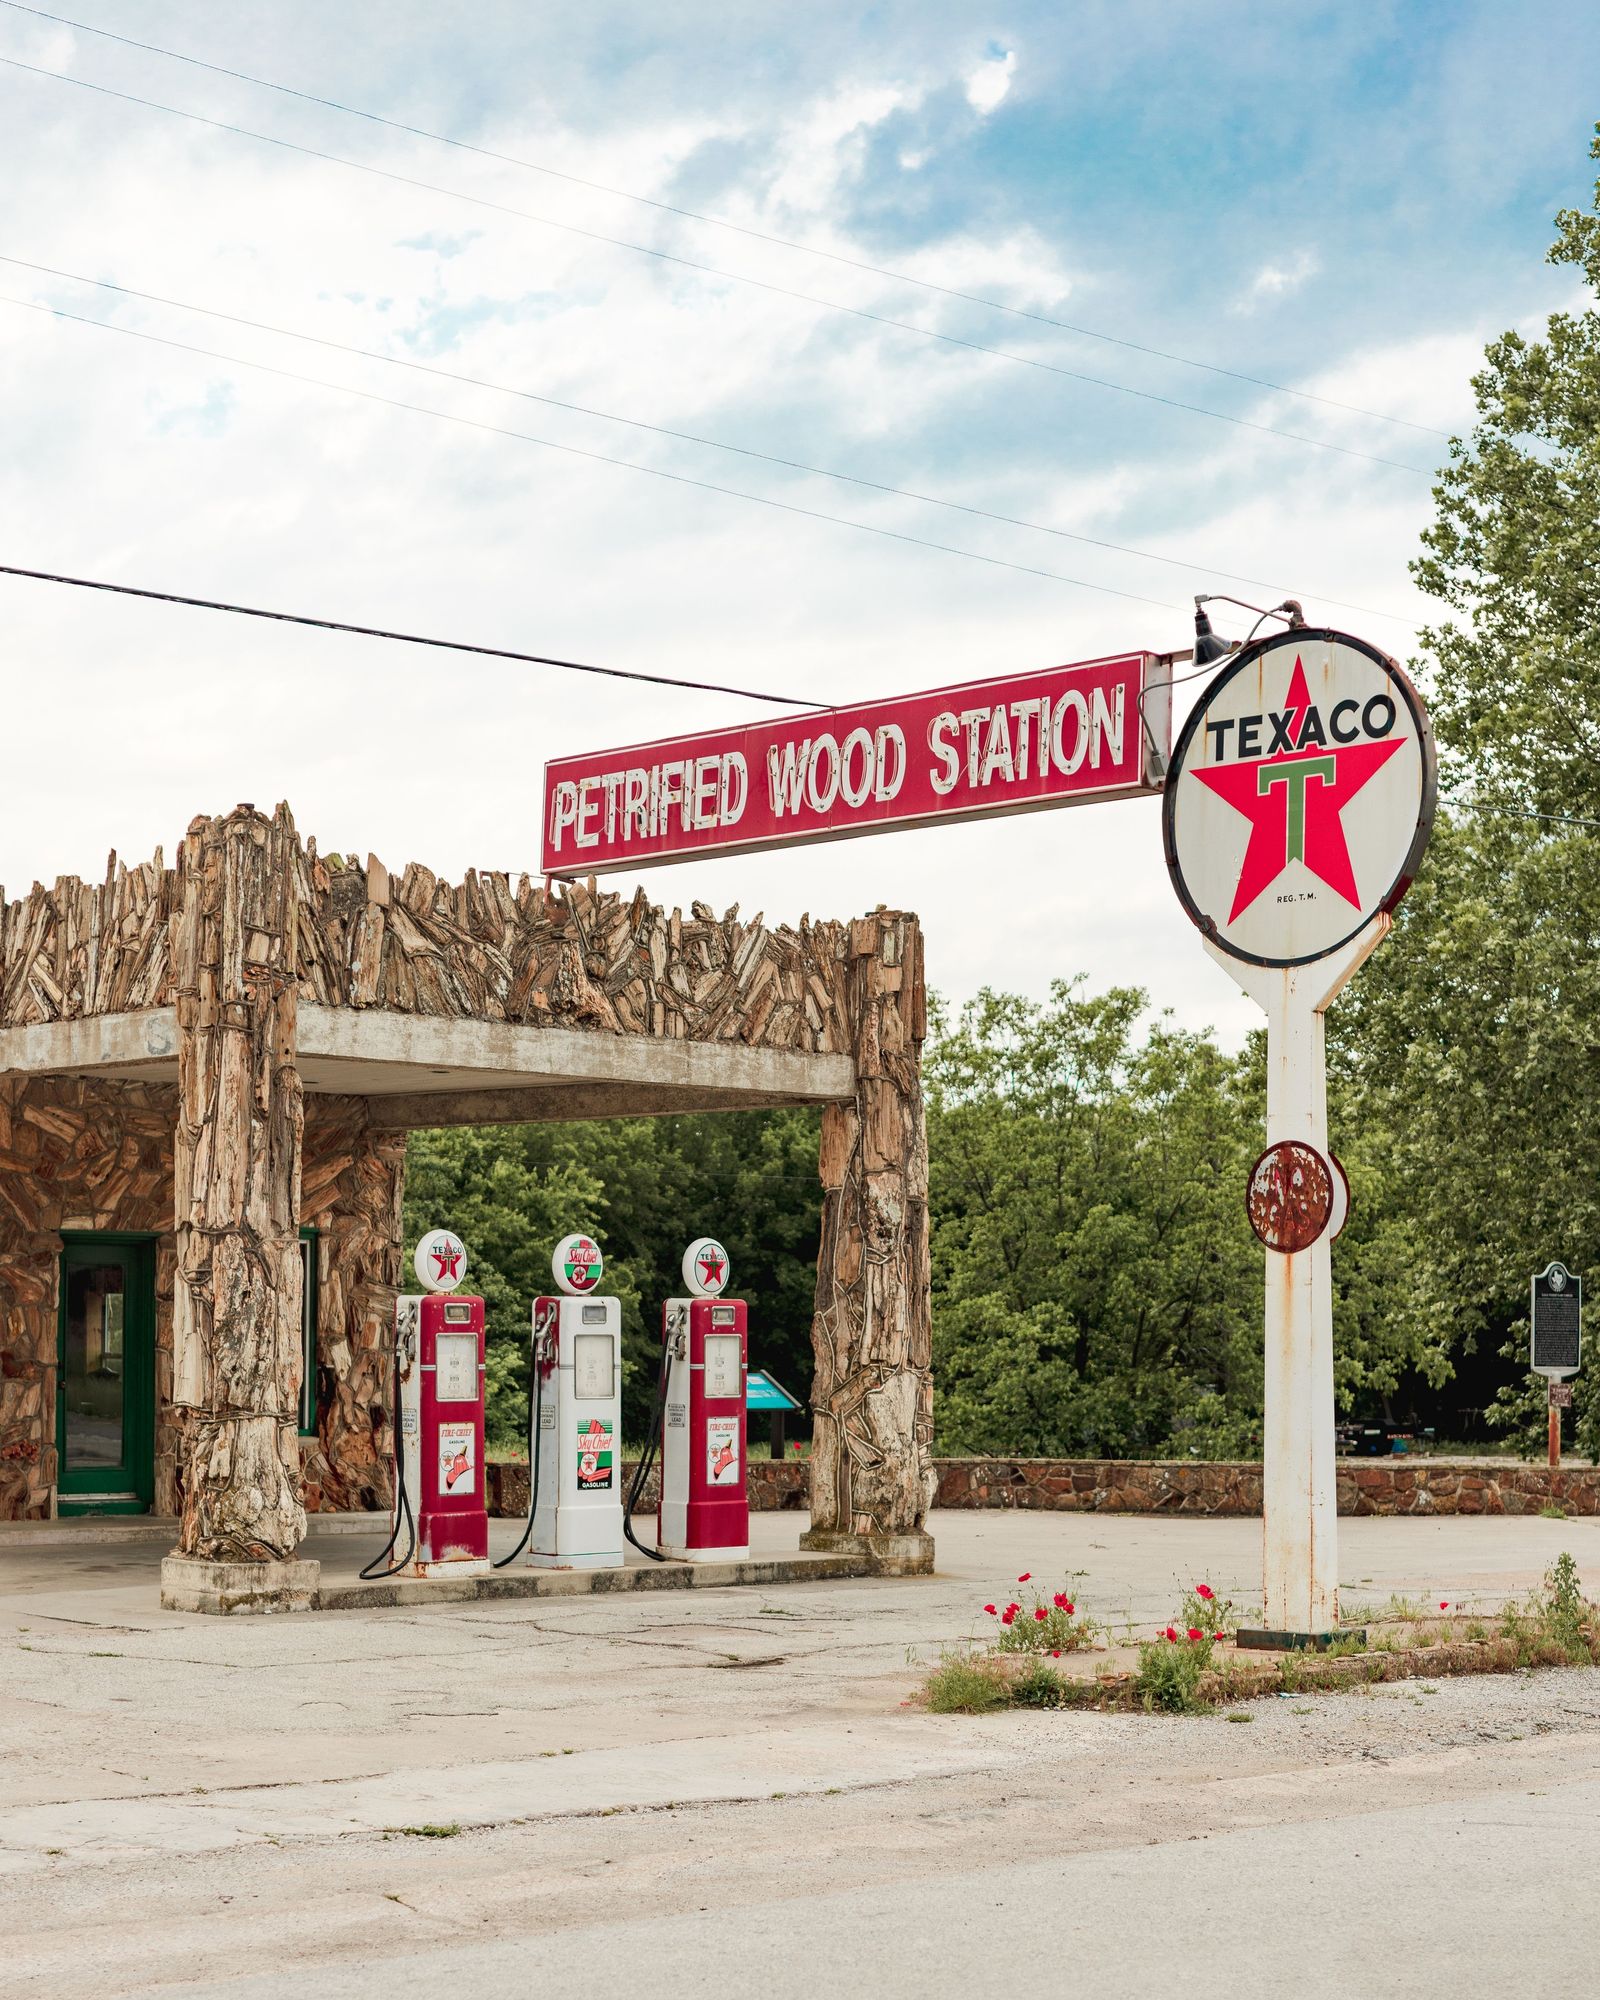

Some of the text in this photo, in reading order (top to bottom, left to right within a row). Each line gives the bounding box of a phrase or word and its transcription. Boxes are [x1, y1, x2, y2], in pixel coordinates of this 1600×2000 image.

[1206, 693, 1397, 762] TEXACO
[551, 682, 1126, 852] PETRIFIED WOOD STATION
[1257, 755, 1336, 865] T
[1276, 894, 1297, 904] REG.
[568, 1248, 597, 1264] Sky Chief
[441, 1429, 472, 1437] FIRE-CHIEF
[578, 1434, 613, 1453] Sky Chief
